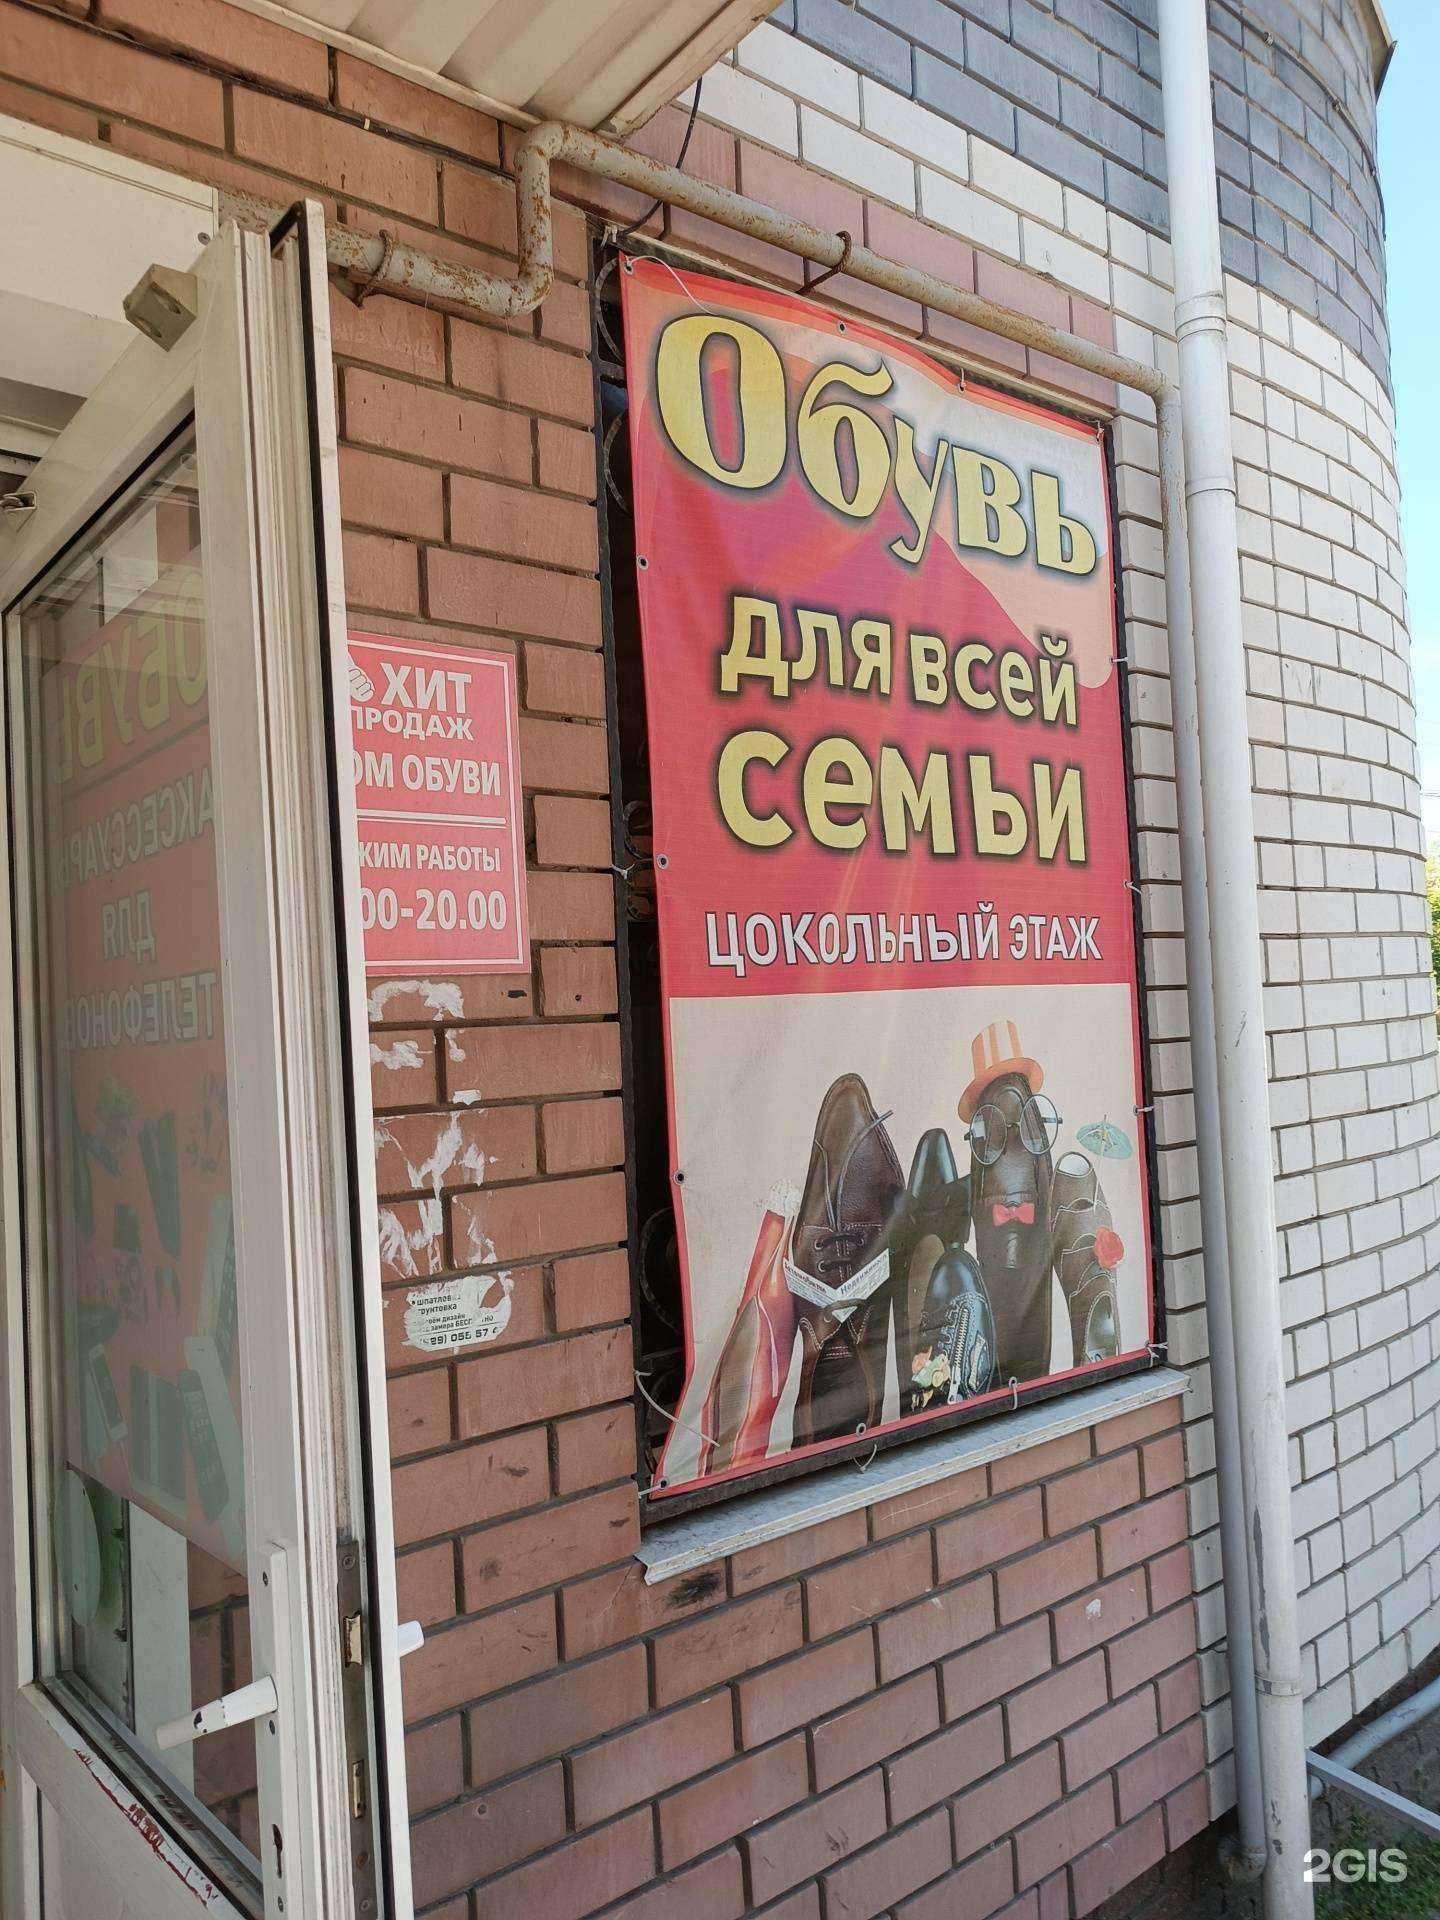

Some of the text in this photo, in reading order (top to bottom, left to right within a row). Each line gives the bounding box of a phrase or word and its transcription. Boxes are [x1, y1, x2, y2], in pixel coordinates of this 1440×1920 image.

[656, 314, 1096, 576] Обувь
[379, 662, 472, 714] ХИТ
[720, 596, 1079, 726] для всей
[401, 753, 501, 796] ОБУВИ
[717, 729, 1087, 863] семьи
[416, 844, 501, 872] РАБОТЫ
[704, 901, 1103, 979] ЦОКОЛЬНЫЙ ЭТАЖ
